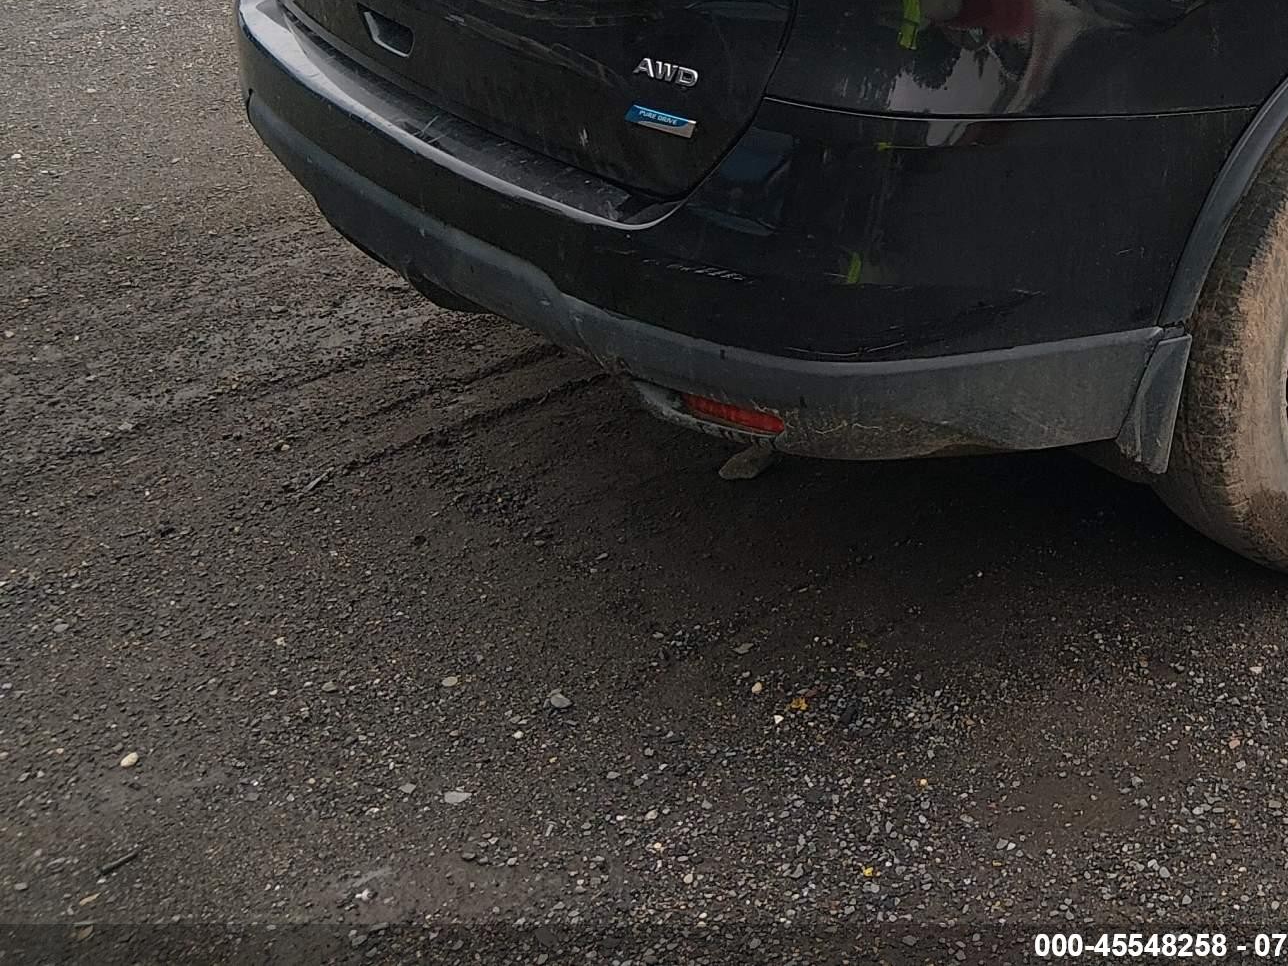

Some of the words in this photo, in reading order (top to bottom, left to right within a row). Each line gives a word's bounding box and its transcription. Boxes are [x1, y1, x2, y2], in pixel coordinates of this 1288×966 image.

[633, 57, 699, 87] AWD
[639, 110, 657, 120] PURE
[657, 115, 678, 126] DRIVE
